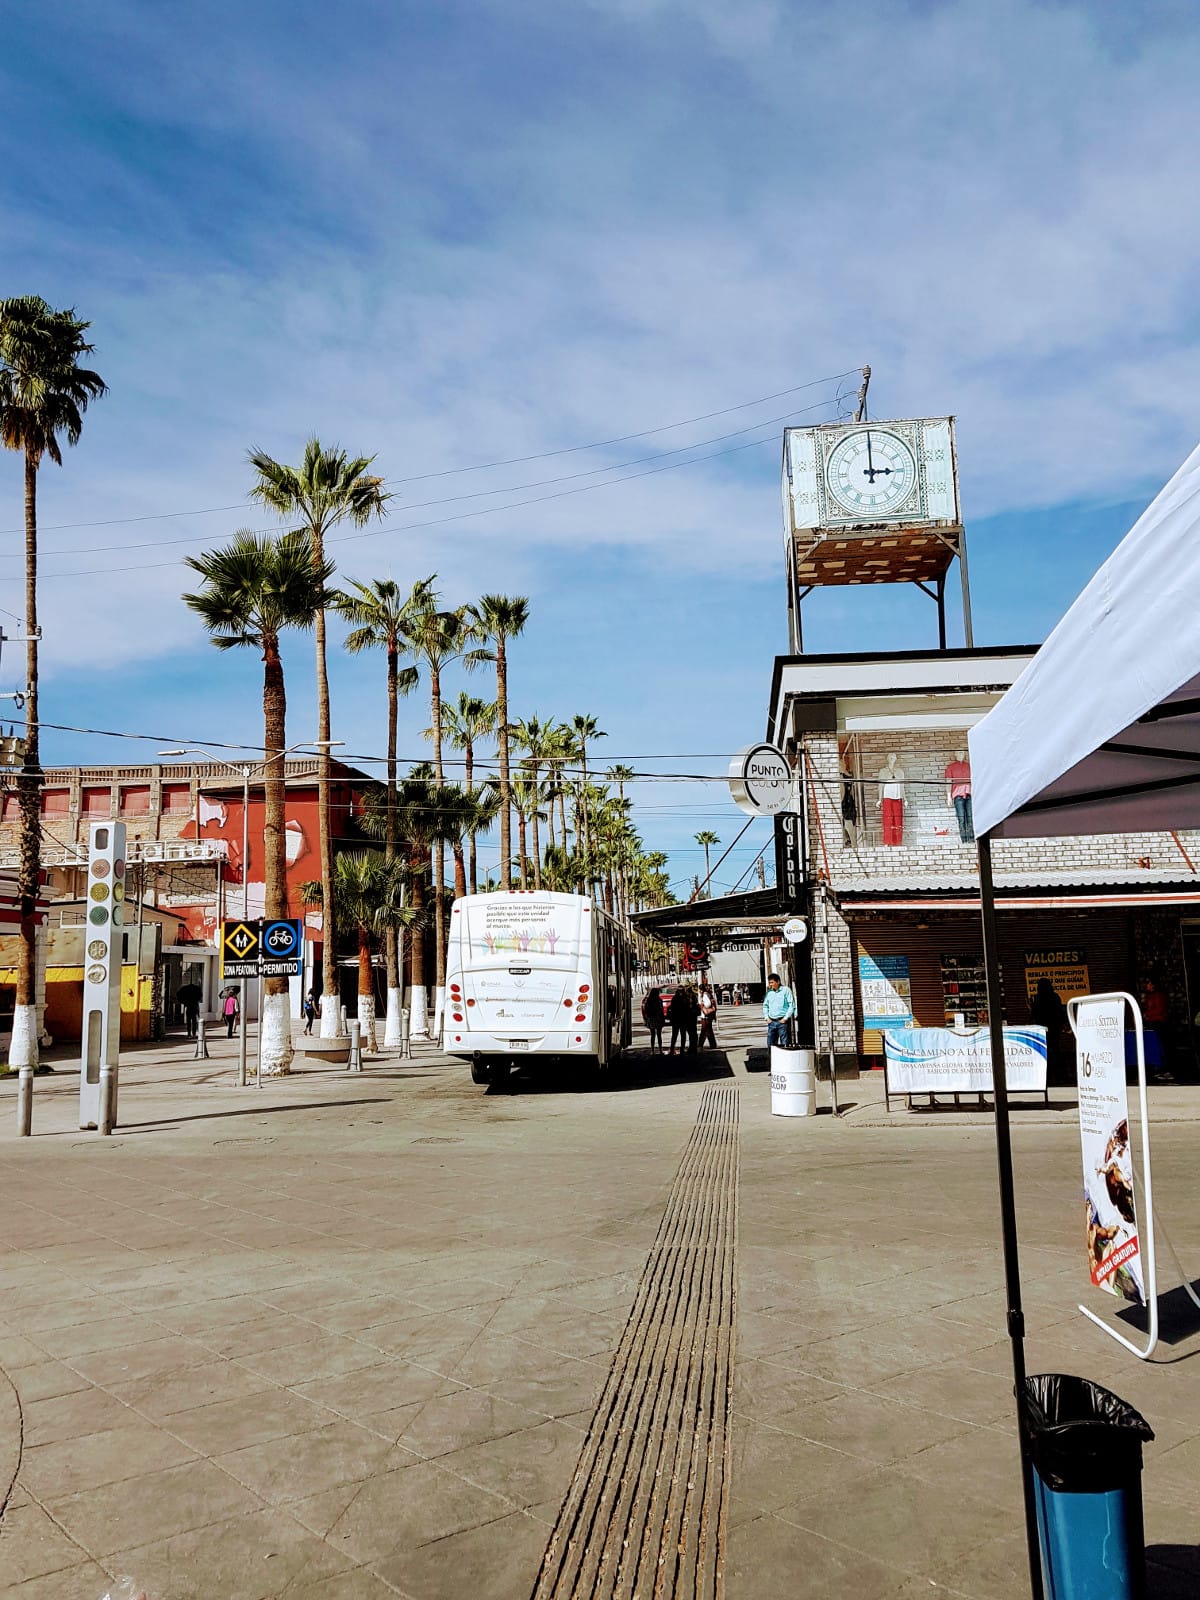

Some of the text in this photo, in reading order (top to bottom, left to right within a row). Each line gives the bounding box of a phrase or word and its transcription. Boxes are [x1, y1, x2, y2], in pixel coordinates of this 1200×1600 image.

[751, 764, 784, 776] PUNTO
[782, 816, 797, 898] Corona
[722, 941, 760, 952] Corona
[1025, 951, 1079, 964] VALORES
[224, 965, 236, 976] ZONA
[263, 962, 298, 975] PERMITIDO
[913, 1048, 956, 1056] CAMINO
[967, 1048, 977, 1056] LA
[980, 1048, 1032, 1056] FEIDAD
